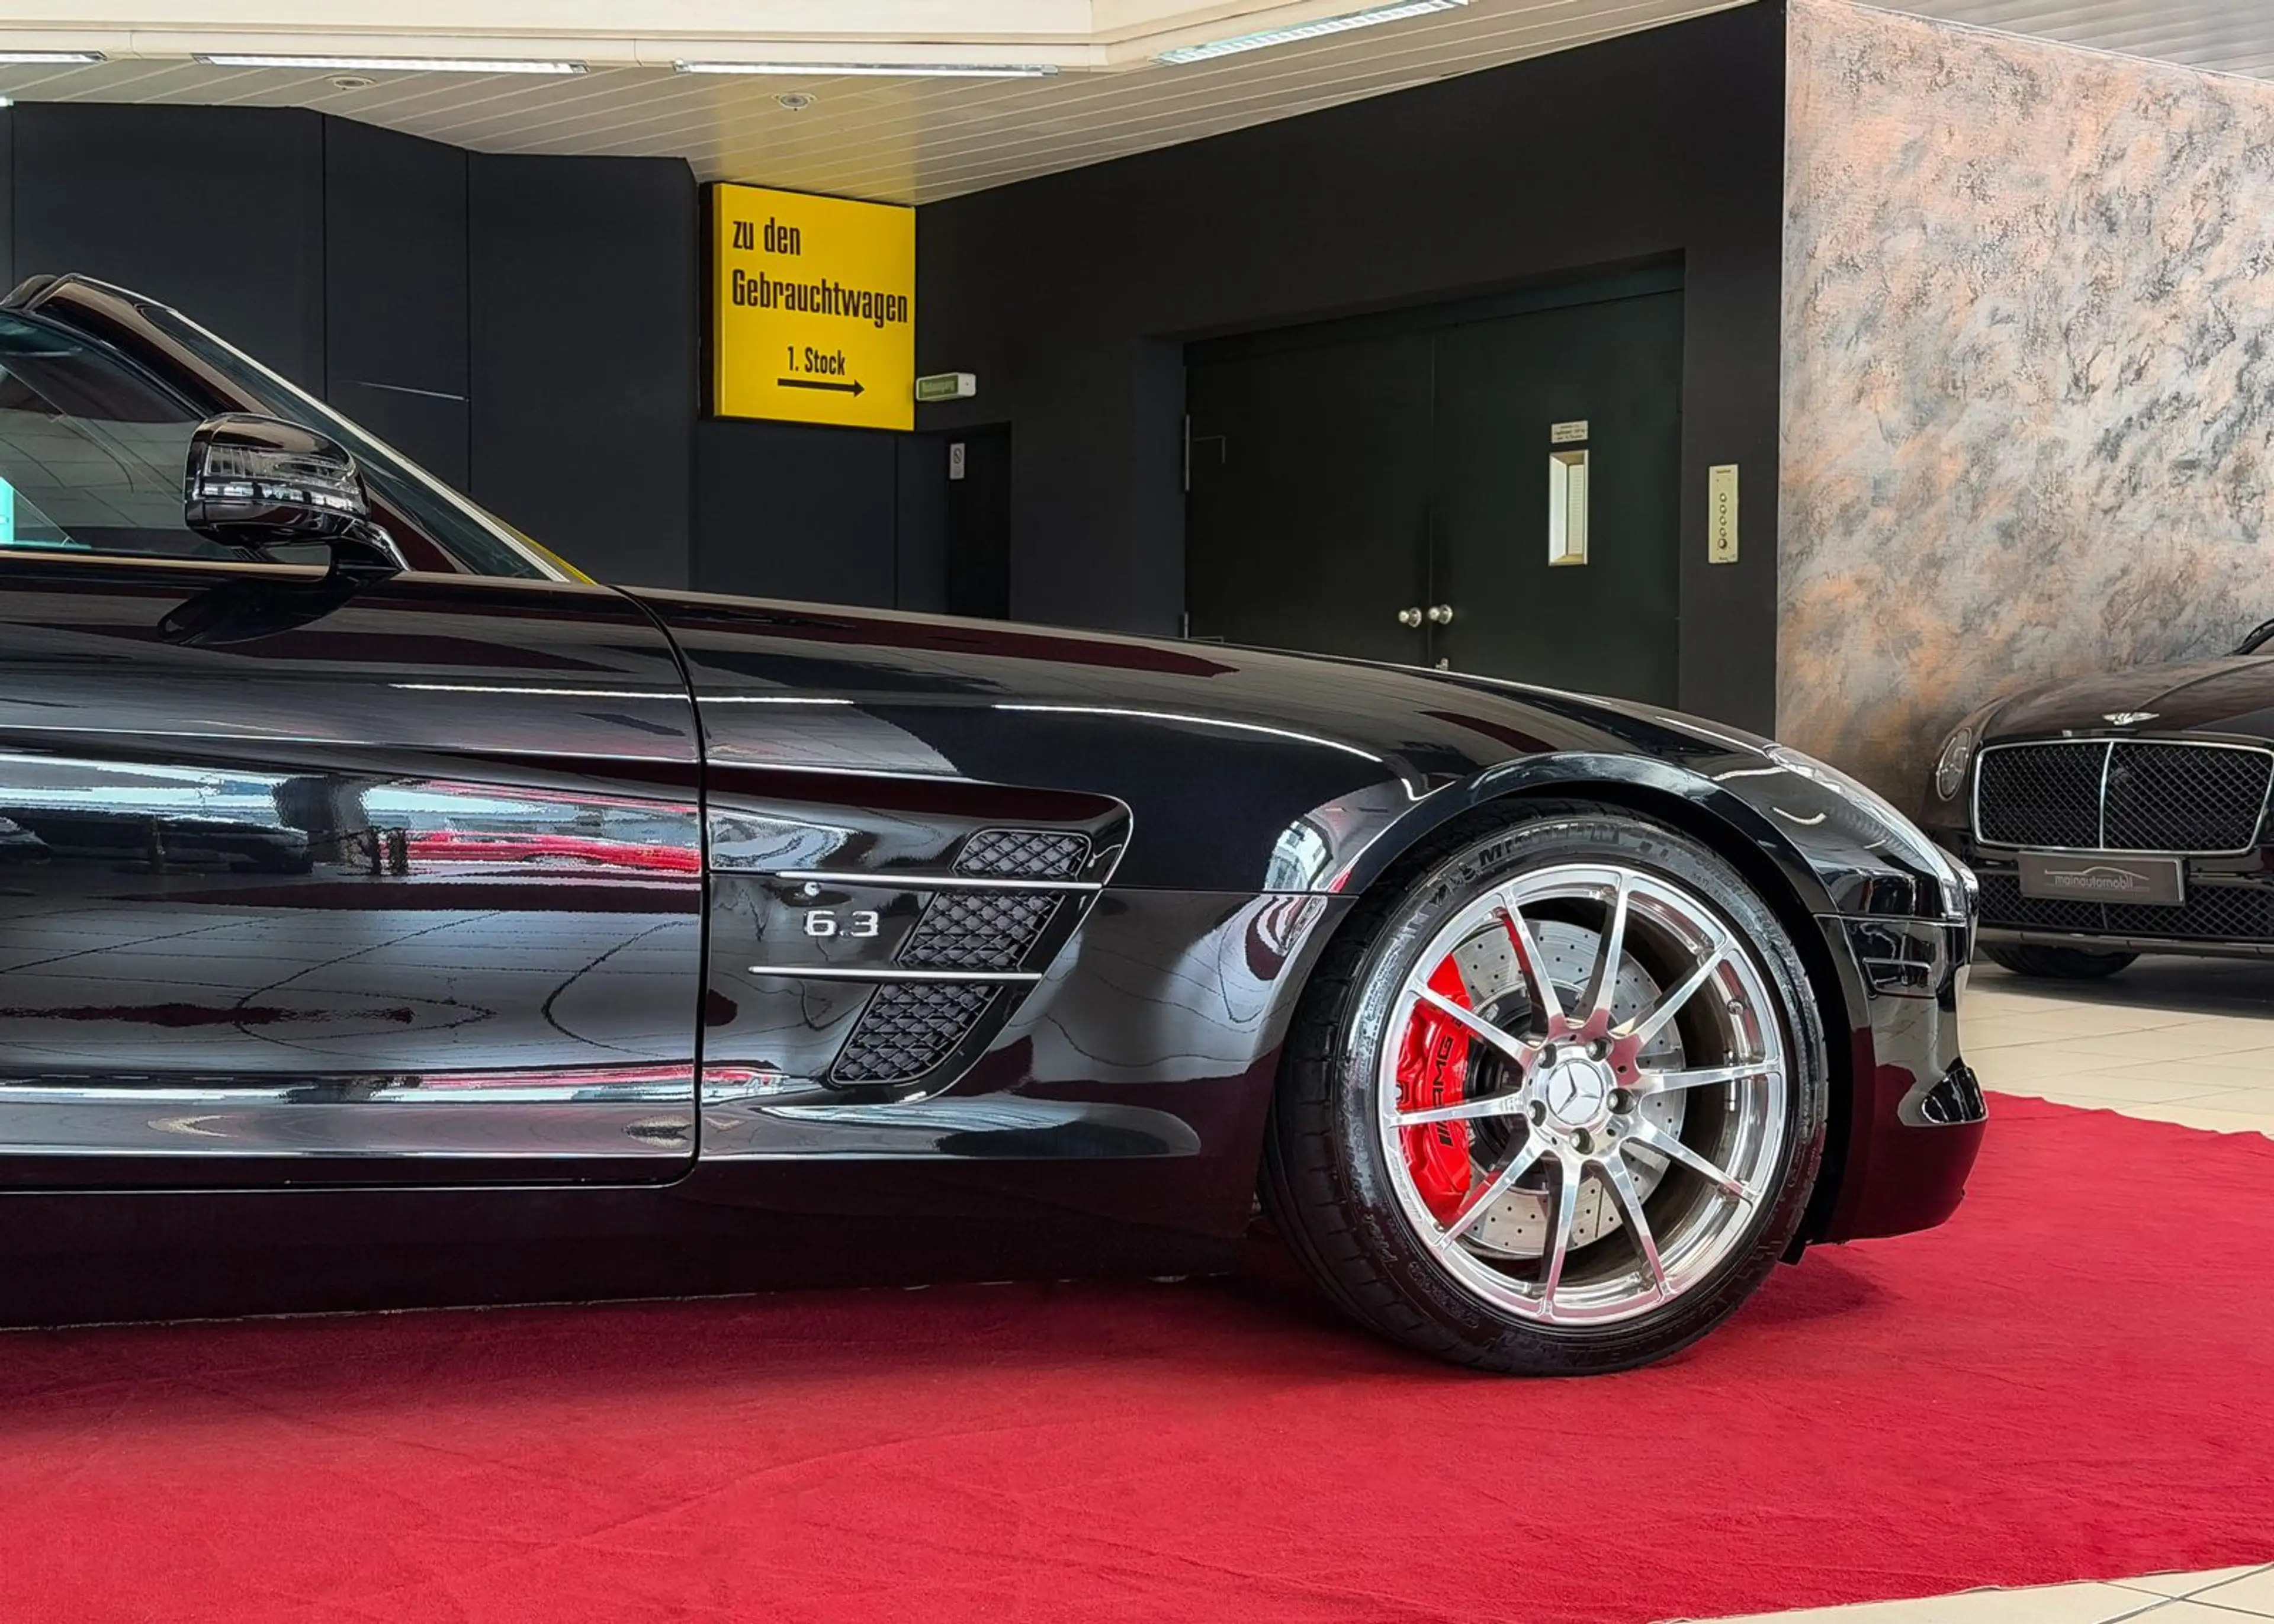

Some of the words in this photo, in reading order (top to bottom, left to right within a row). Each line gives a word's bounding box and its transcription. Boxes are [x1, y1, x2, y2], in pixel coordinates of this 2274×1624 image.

[733, 220, 754, 250] zu
[763, 217, 801, 255] den
[732, 268, 908, 329] Gebrauchtwagen
[787, 346, 799, 371] 1.
[804, 347, 846, 375] Stock
[805, 910, 879, 937] 6.3
